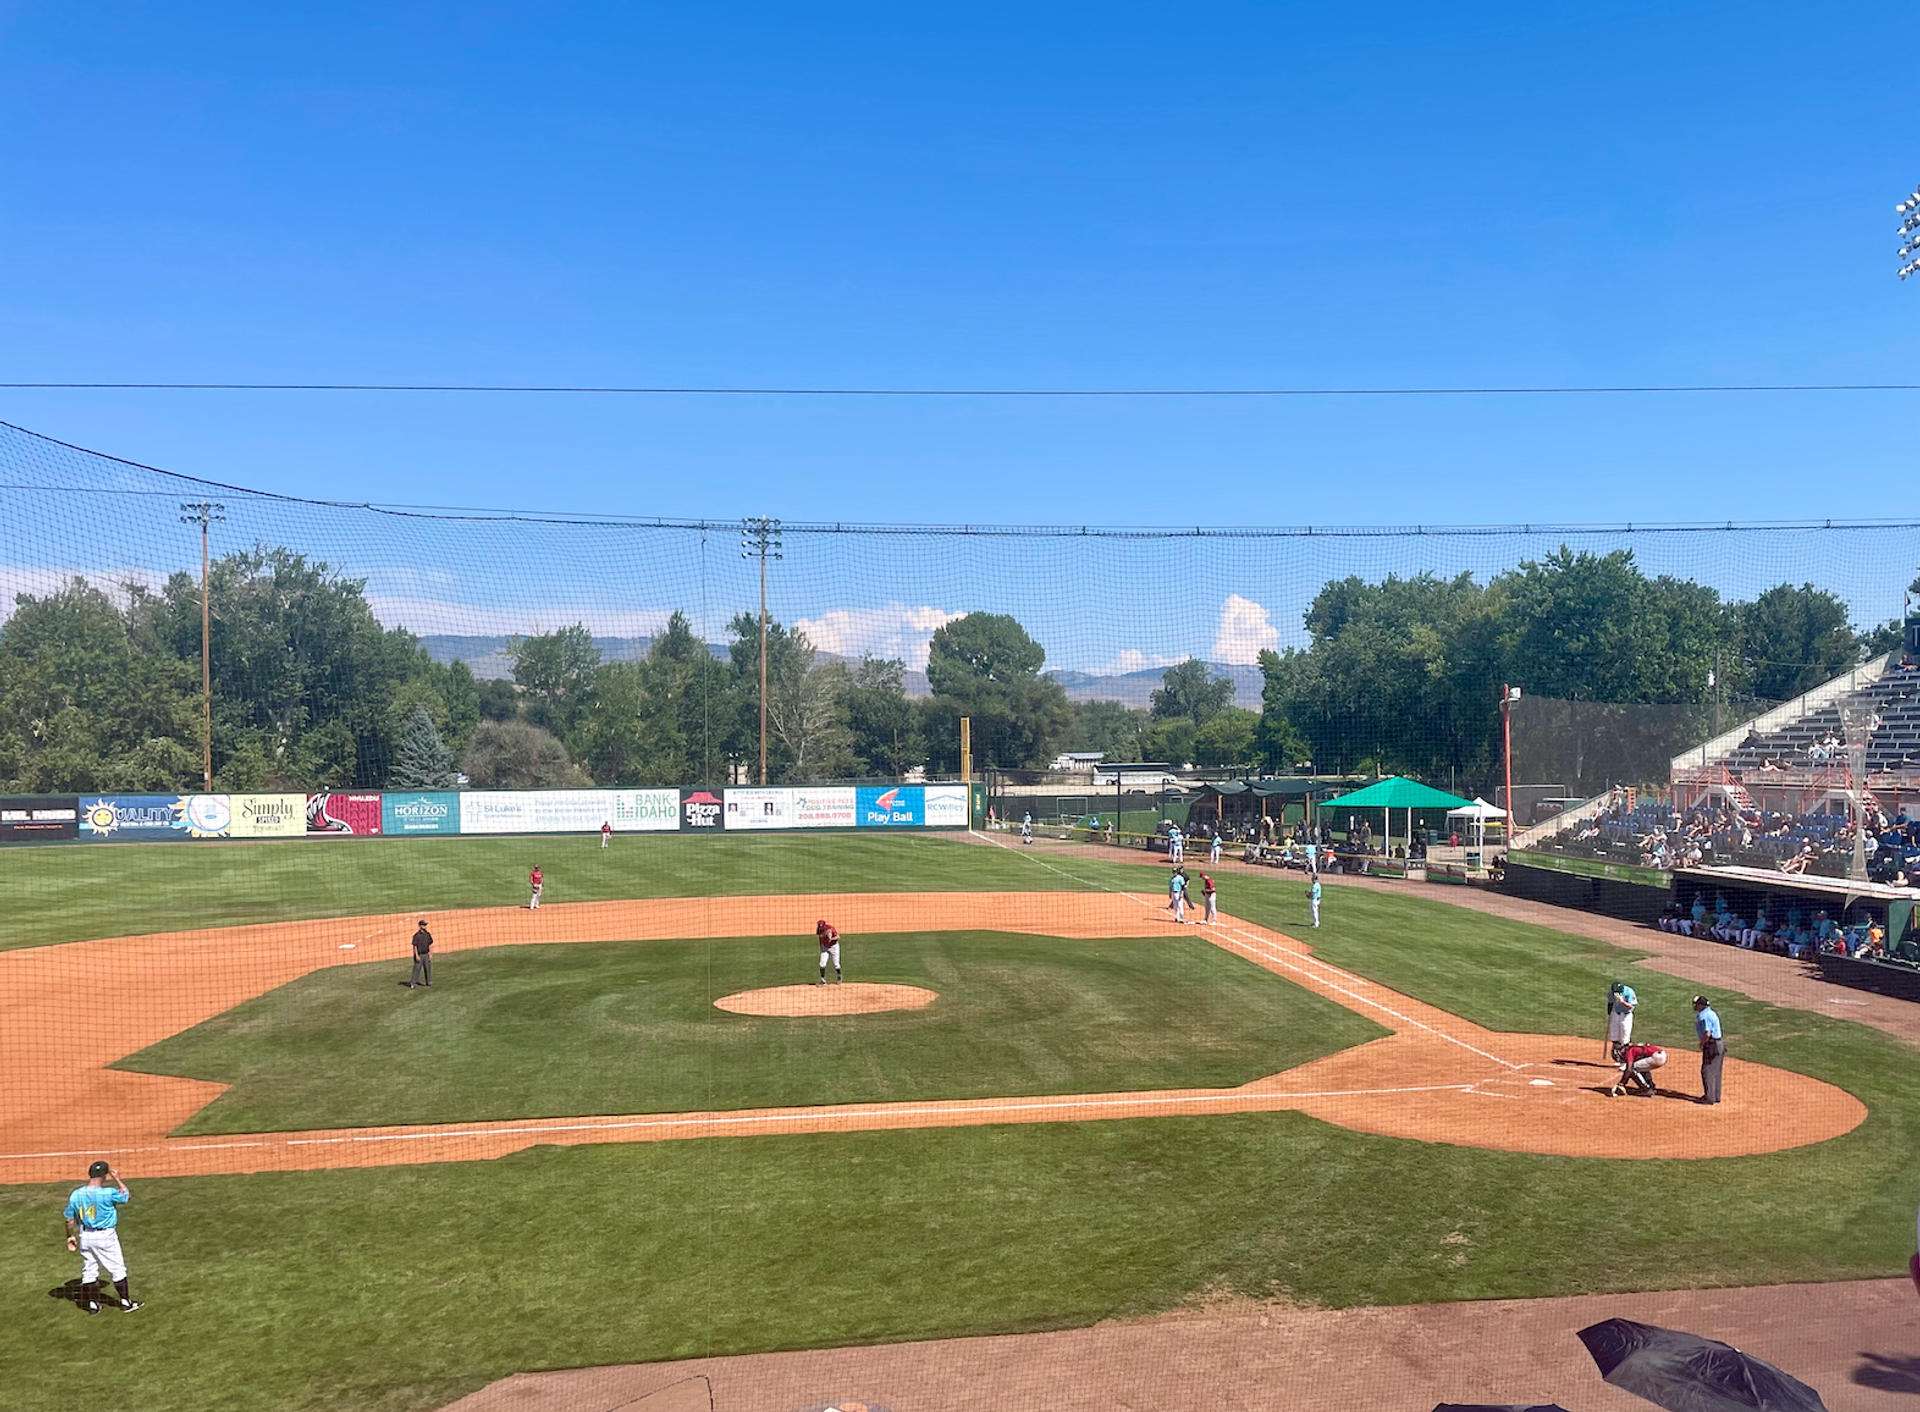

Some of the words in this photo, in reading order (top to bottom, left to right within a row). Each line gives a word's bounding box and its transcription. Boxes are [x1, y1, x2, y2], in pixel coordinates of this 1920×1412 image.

[635, 793, 671, 806] BANK
[242, 798, 295, 820] Simply
[395, 806, 447, 815] HORIZON
[635, 805, 677, 818] IDAHO
[685, 803, 720, 816] Pizza
[686, 813, 716, 826] Hut
[868, 812, 890, 824] Play
[892, 811, 914, 822] Ball
[79, 1205, 96, 1220] 14
